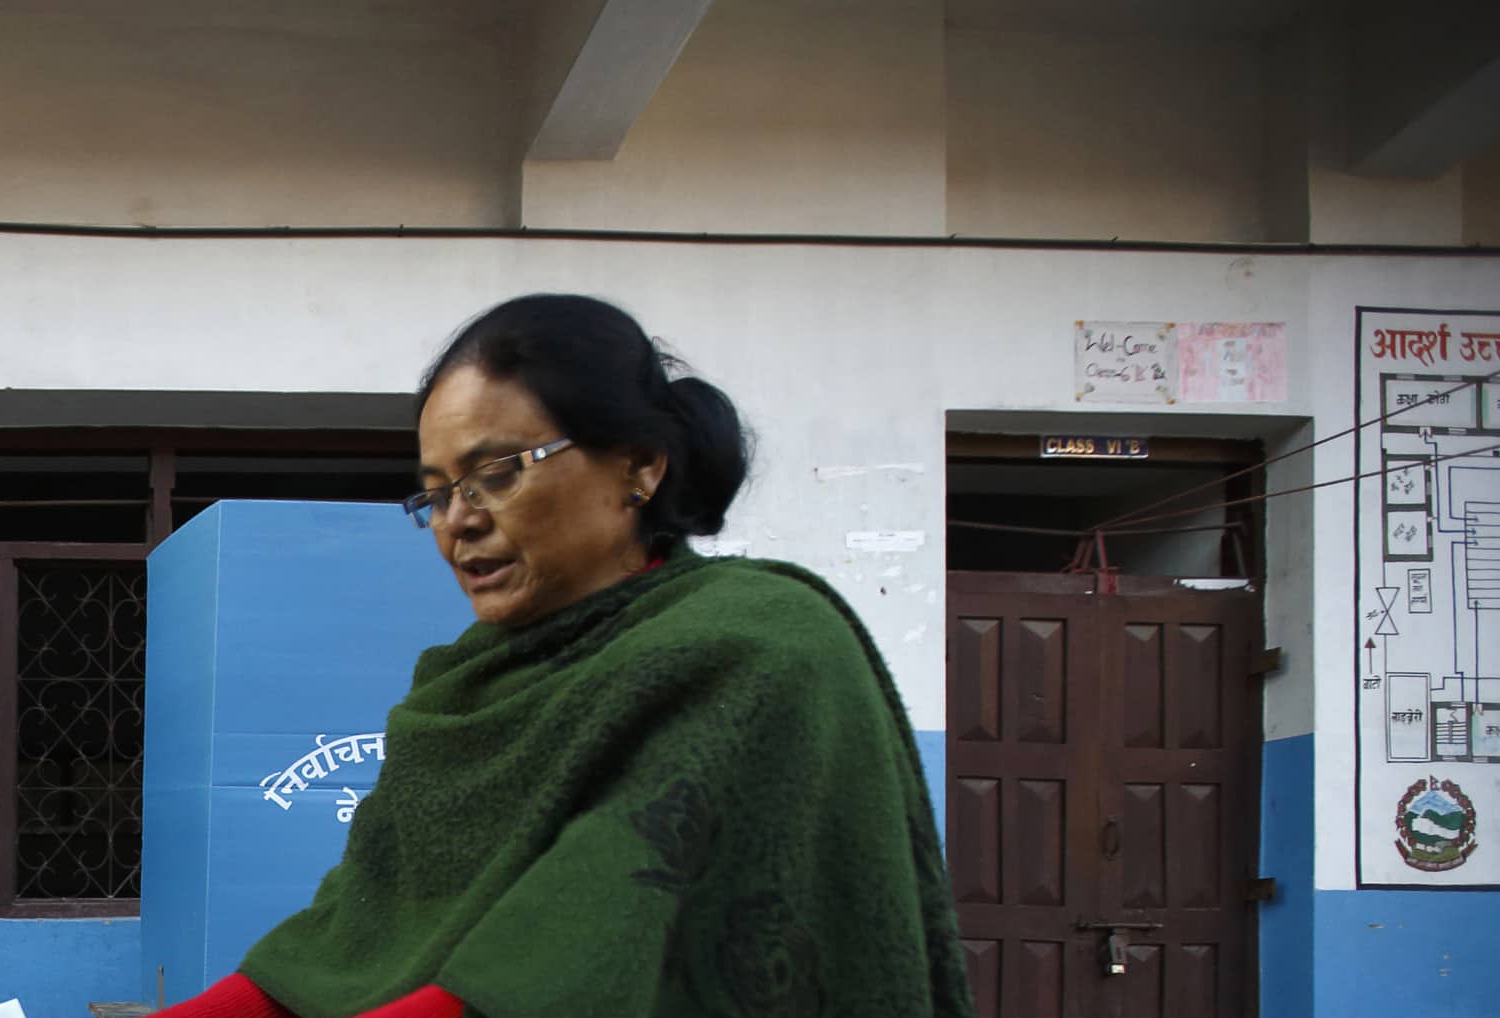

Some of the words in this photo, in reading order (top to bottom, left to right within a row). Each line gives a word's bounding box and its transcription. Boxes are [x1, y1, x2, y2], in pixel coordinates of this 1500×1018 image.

[1370, 323, 1451, 367] आदर्श
[1046, 438, 1095, 453] CLASS
[1108, 439, 1122, 454] VI
[260, 732, 386, 811] निर्वाचन
